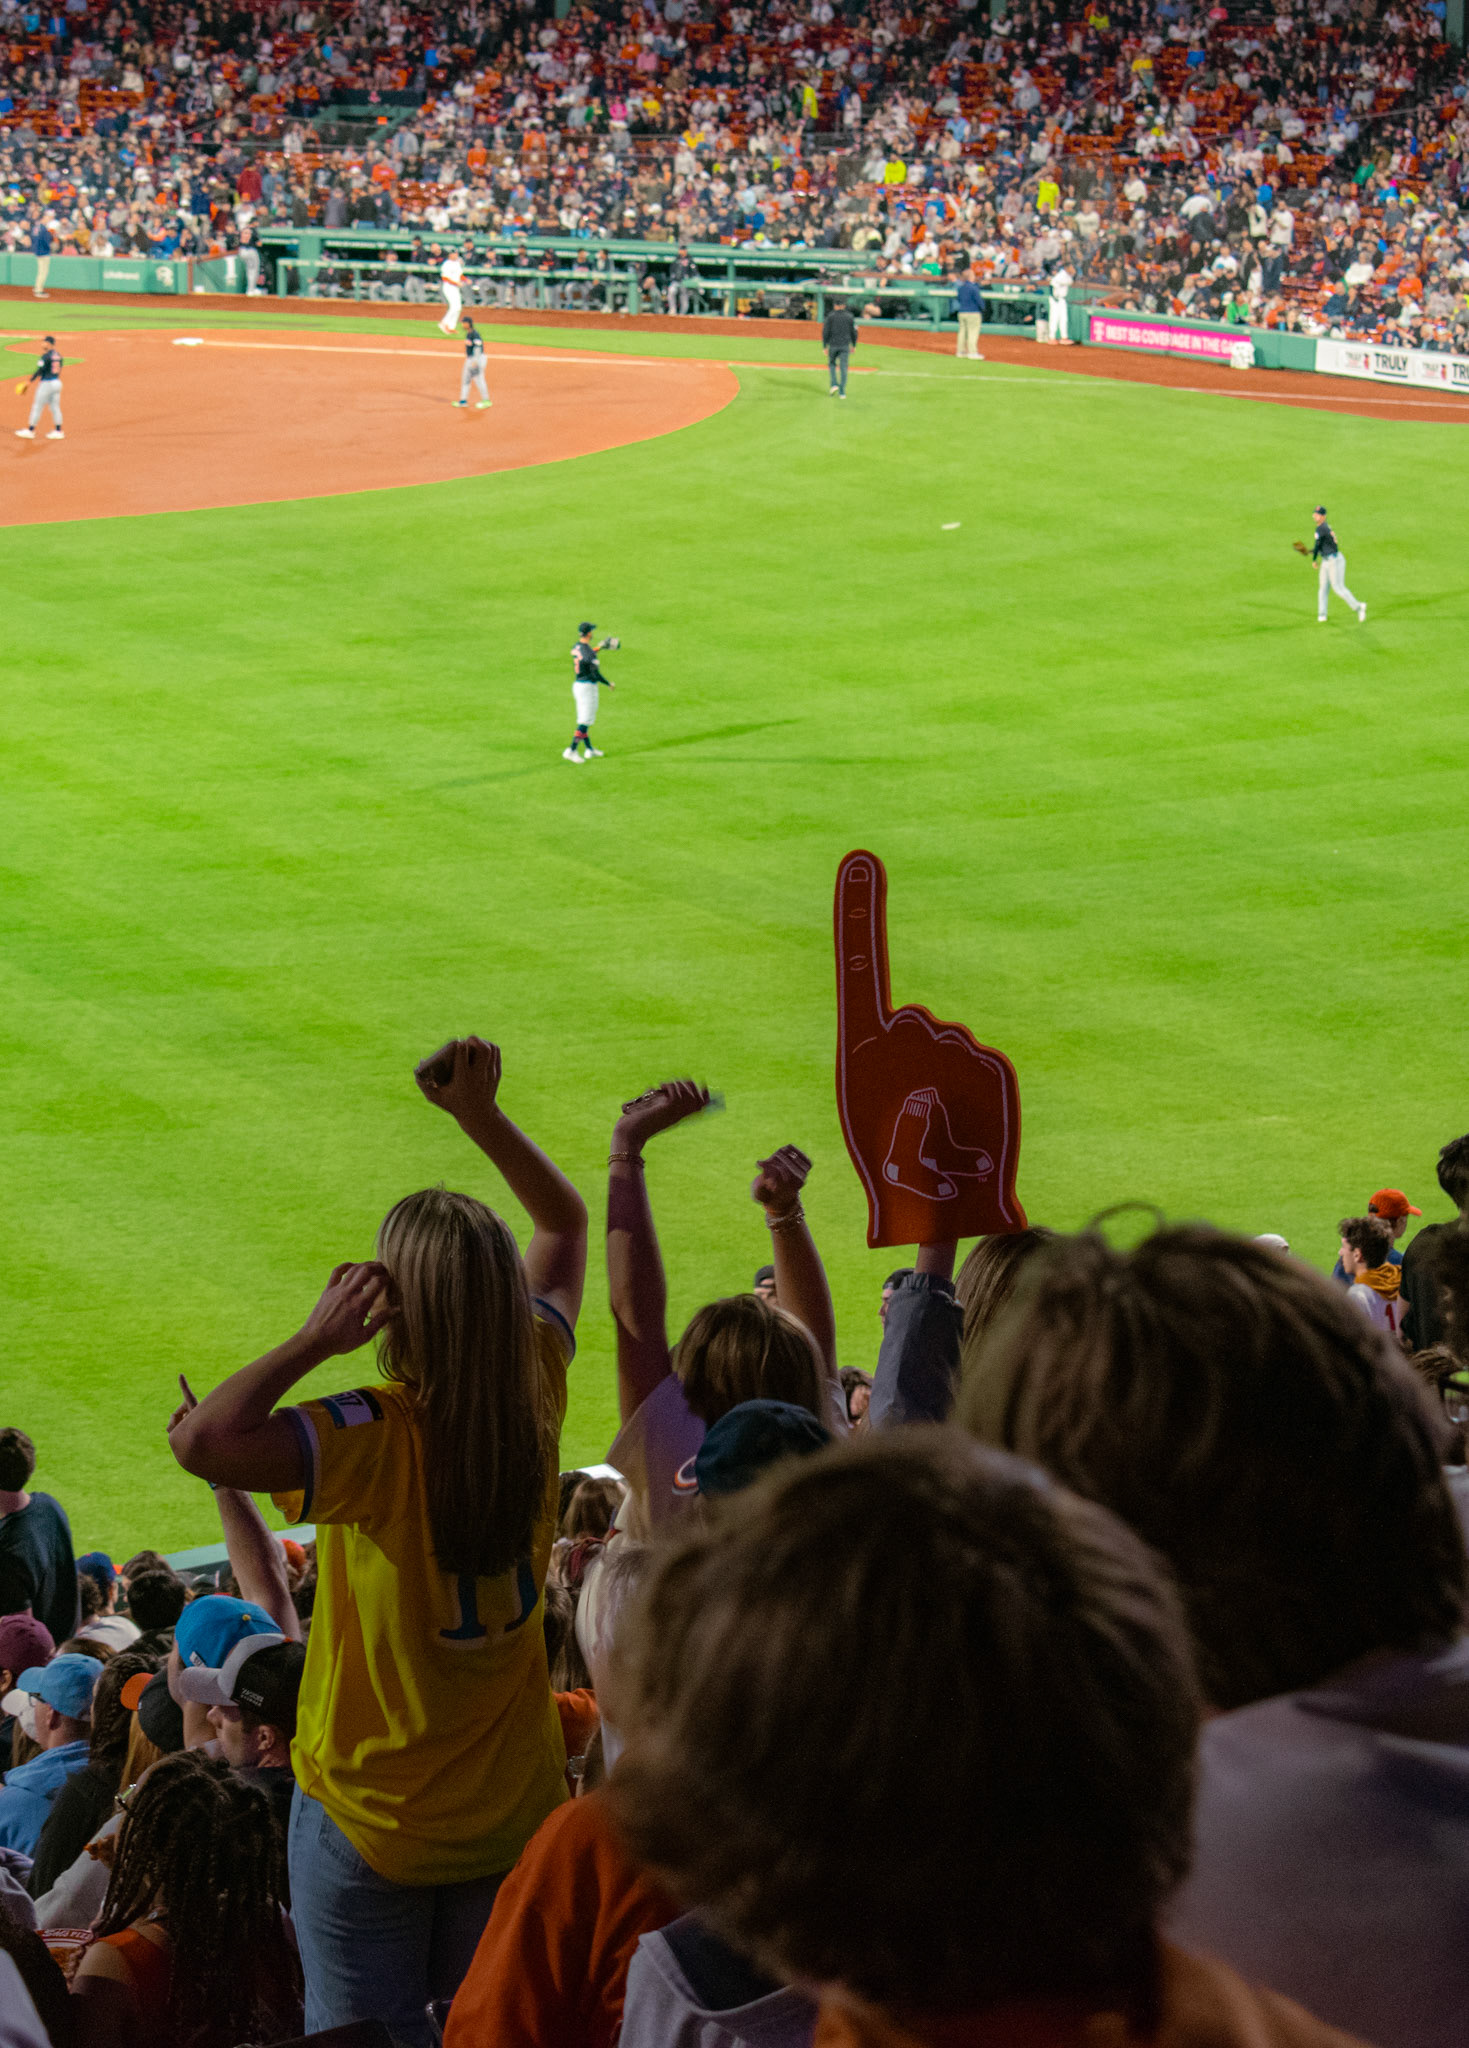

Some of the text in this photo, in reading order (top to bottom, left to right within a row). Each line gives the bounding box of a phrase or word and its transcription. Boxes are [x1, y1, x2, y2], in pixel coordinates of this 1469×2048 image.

[1106, 325, 1127, 341] BEST
[1142, 329, 1190, 349] COVERAGE
[1191, 334, 1202, 350] IN
[1202, 335, 1220, 353] THE
[1374, 353, 1408, 371] TRULY
